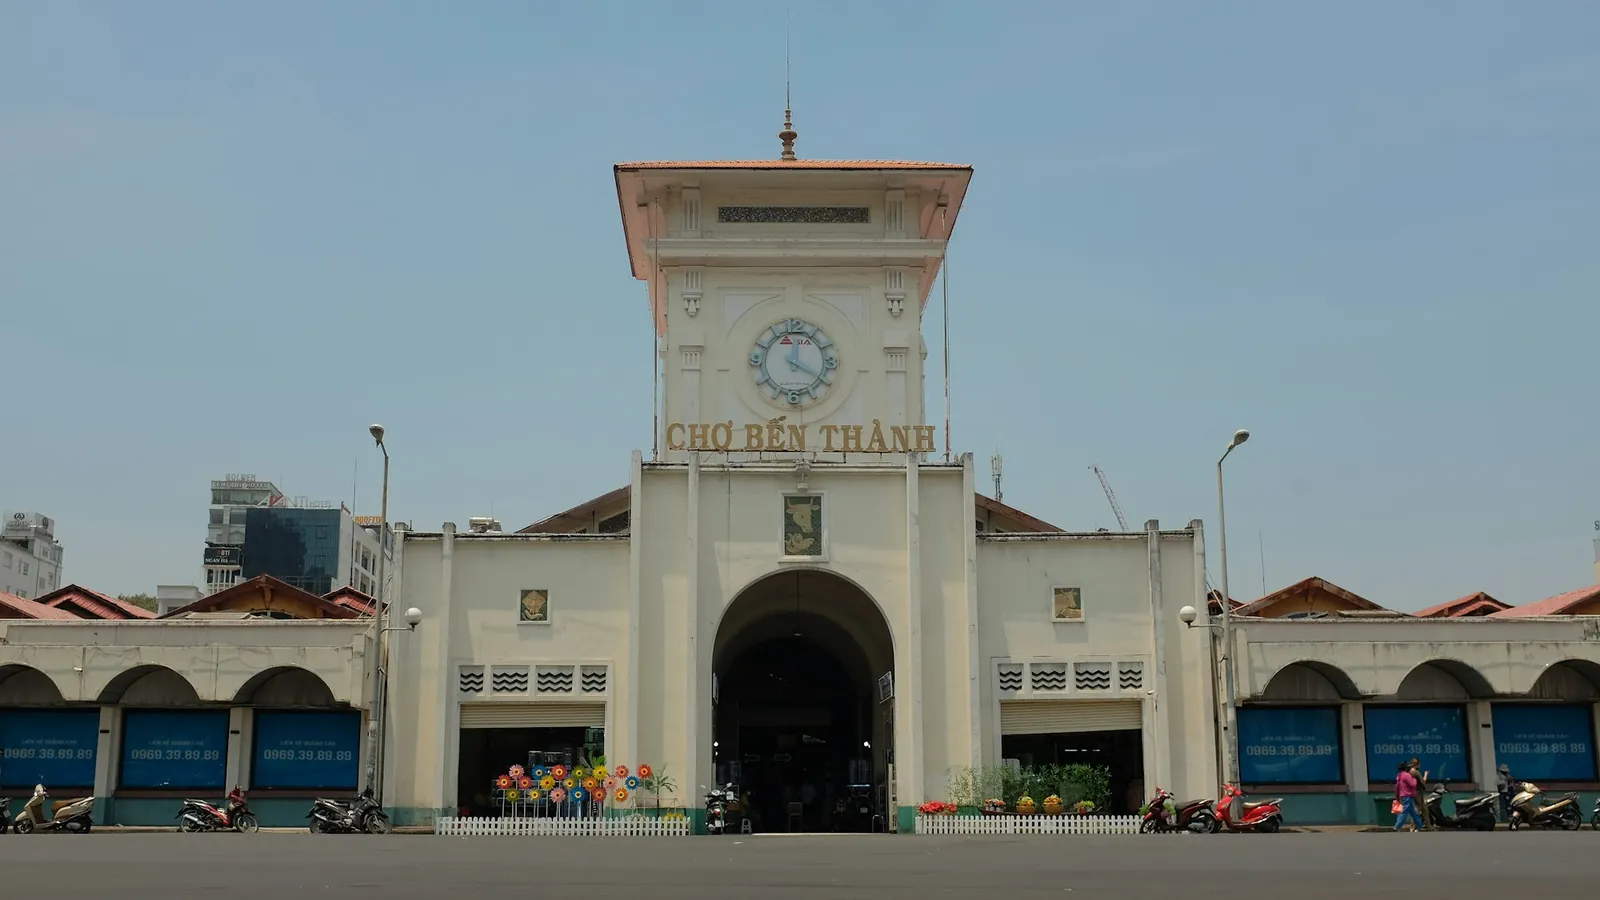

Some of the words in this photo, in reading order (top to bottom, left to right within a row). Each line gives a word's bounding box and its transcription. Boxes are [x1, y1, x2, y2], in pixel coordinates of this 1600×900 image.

[785, 319, 804, 333] 12
[750, 352, 762, 366] 9
[825, 355, 838, 369] 3
[788, 390, 800, 404] 6
[666, 420, 734, 453] CHỢ
[744, 415, 808, 451] BẾN
[819, 418, 937, 452] THÀNH
[4, 748, 93, 760] 0969.39.89.89
[1246, 744, 1332, 756] 0969.39.89.89
[1374, 743, 1460, 755] 0969.39.89.89
[1500, 742, 1586, 754] 0969.39.89.89
[131, 749, 219, 760] 0969.39.89.89
[264, 749, 352, 761] 0969.39.89.89
